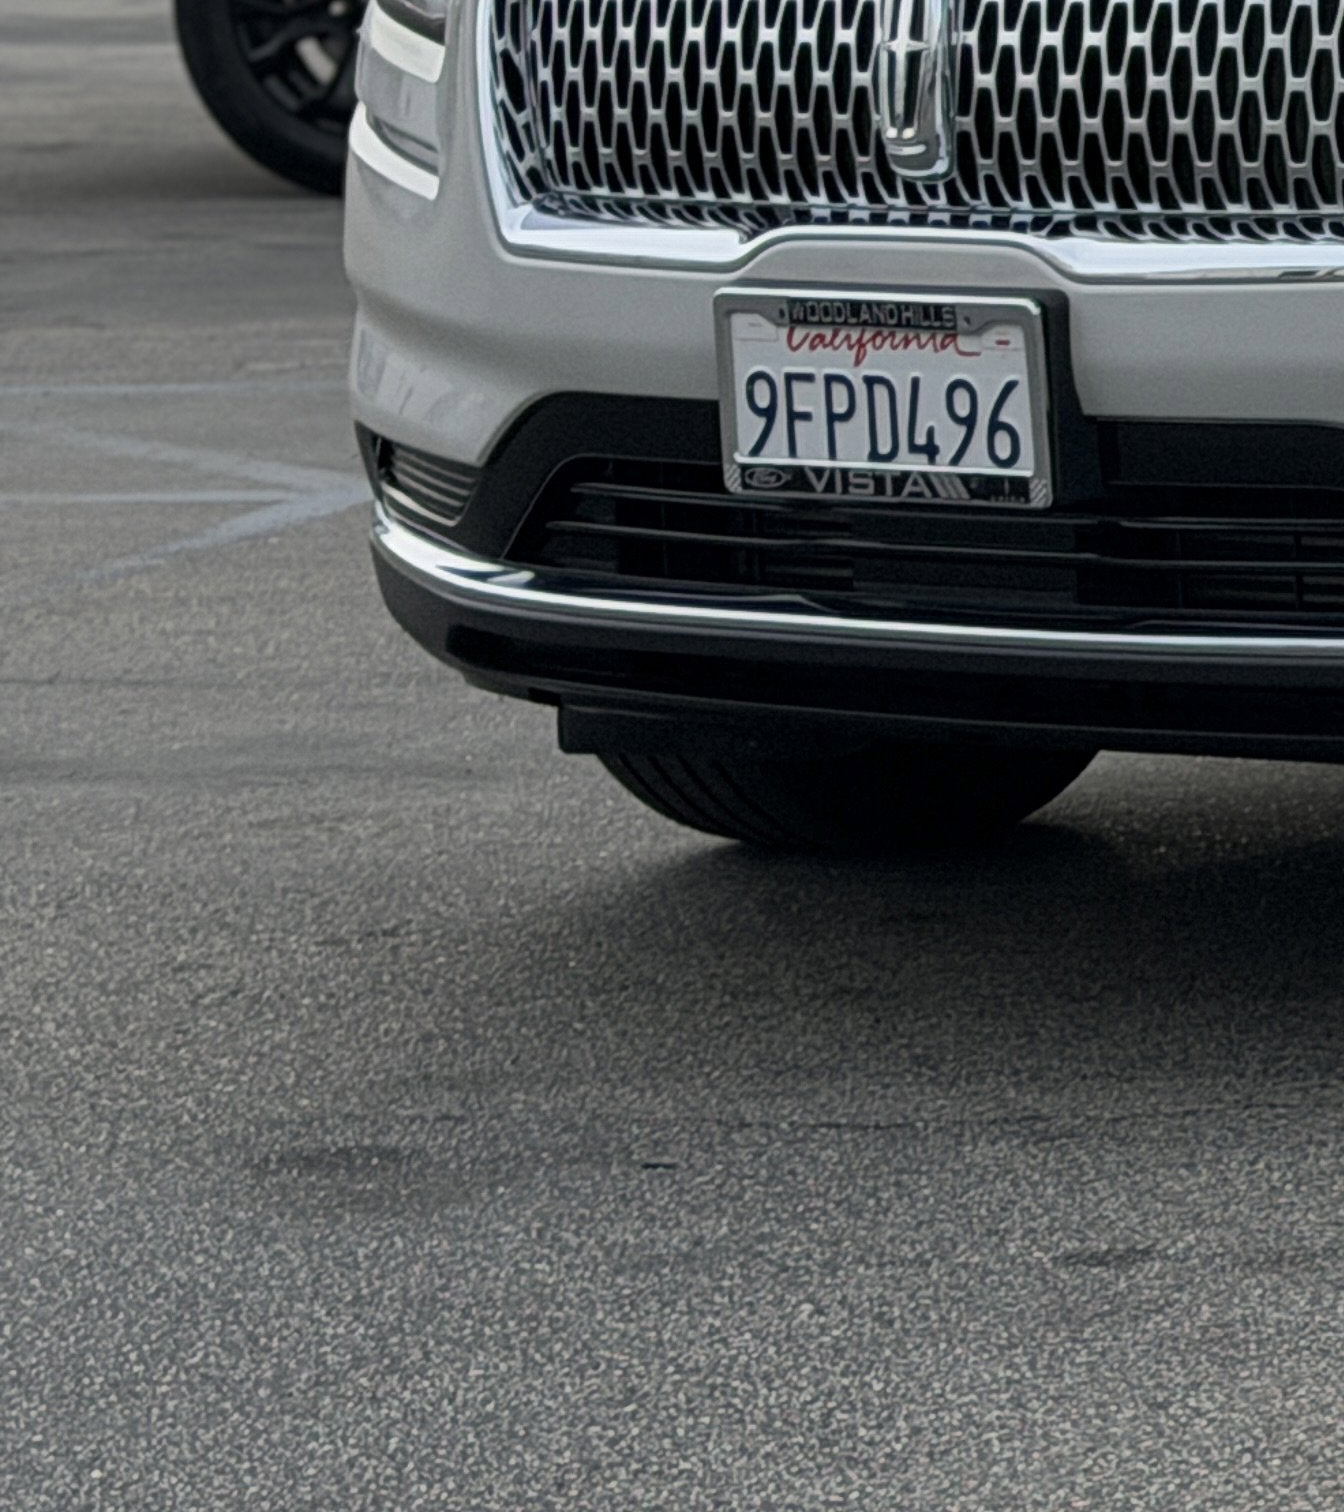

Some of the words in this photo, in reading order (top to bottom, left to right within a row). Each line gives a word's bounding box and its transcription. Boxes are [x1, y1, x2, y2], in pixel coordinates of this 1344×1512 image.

[792, 301, 898, 325] WOODLAND
[902, 305, 955, 326] HILLS
[786, 326, 981, 367] California
[745, 369, 1021, 469] 9FPD496
[804, 468, 931, 498] VISTA
